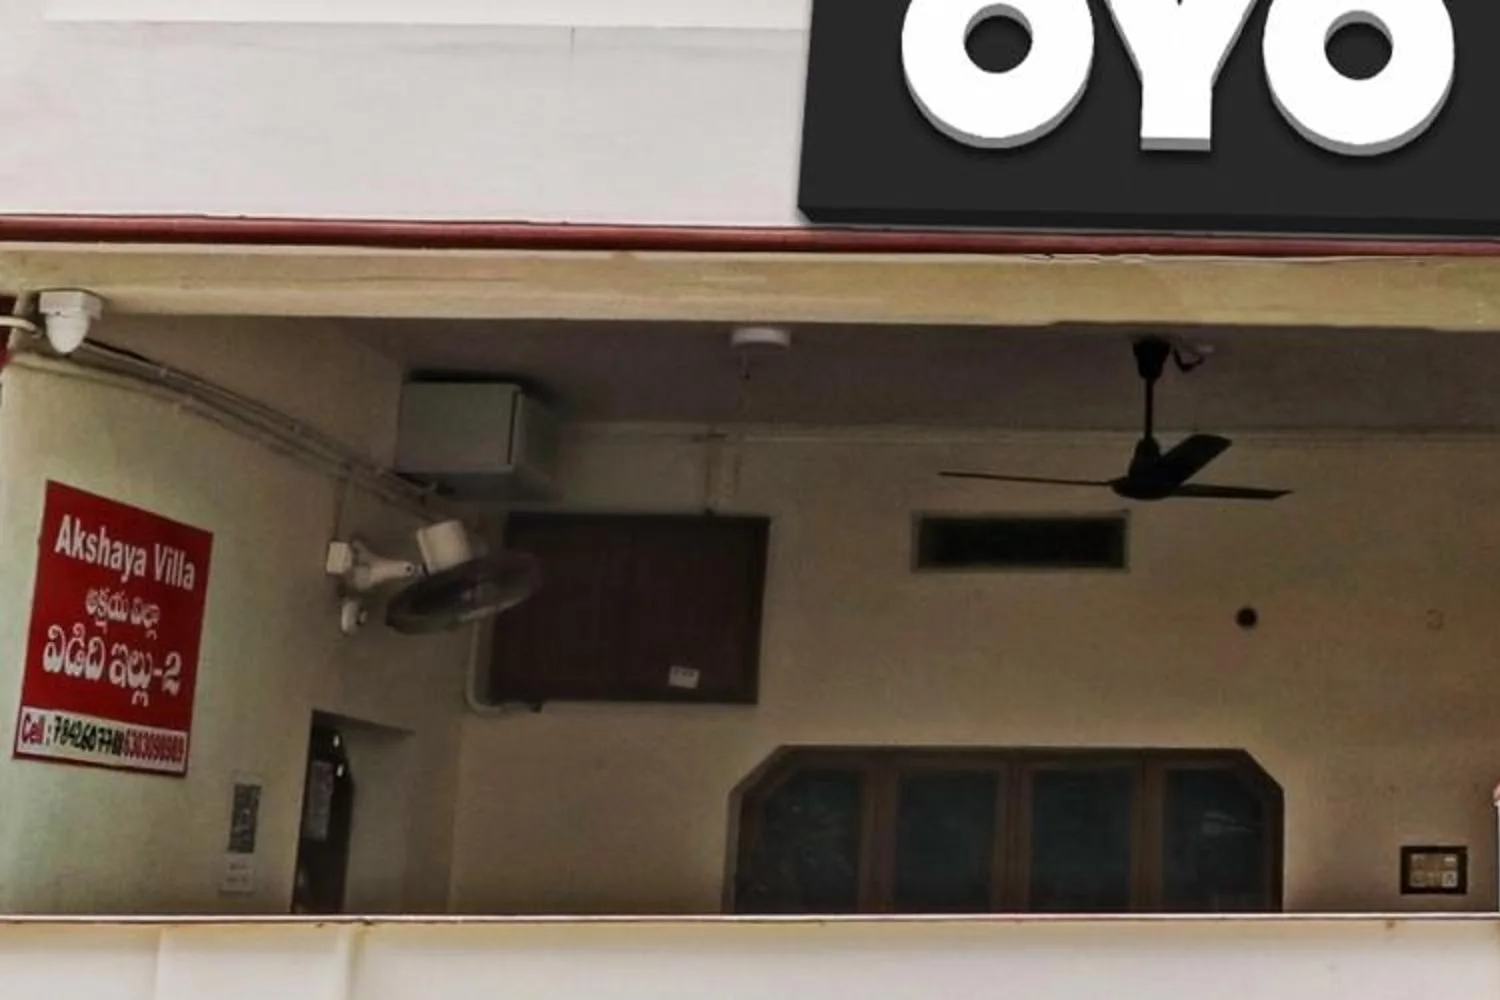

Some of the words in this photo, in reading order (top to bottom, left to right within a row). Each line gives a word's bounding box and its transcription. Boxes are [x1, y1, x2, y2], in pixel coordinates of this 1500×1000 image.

[901, 0, 1454, 156] OYO
[54, 513, 147, 584] Akshaya
[154, 543, 196, 591] Villa
[43, 622, 106, 680] విడిది
